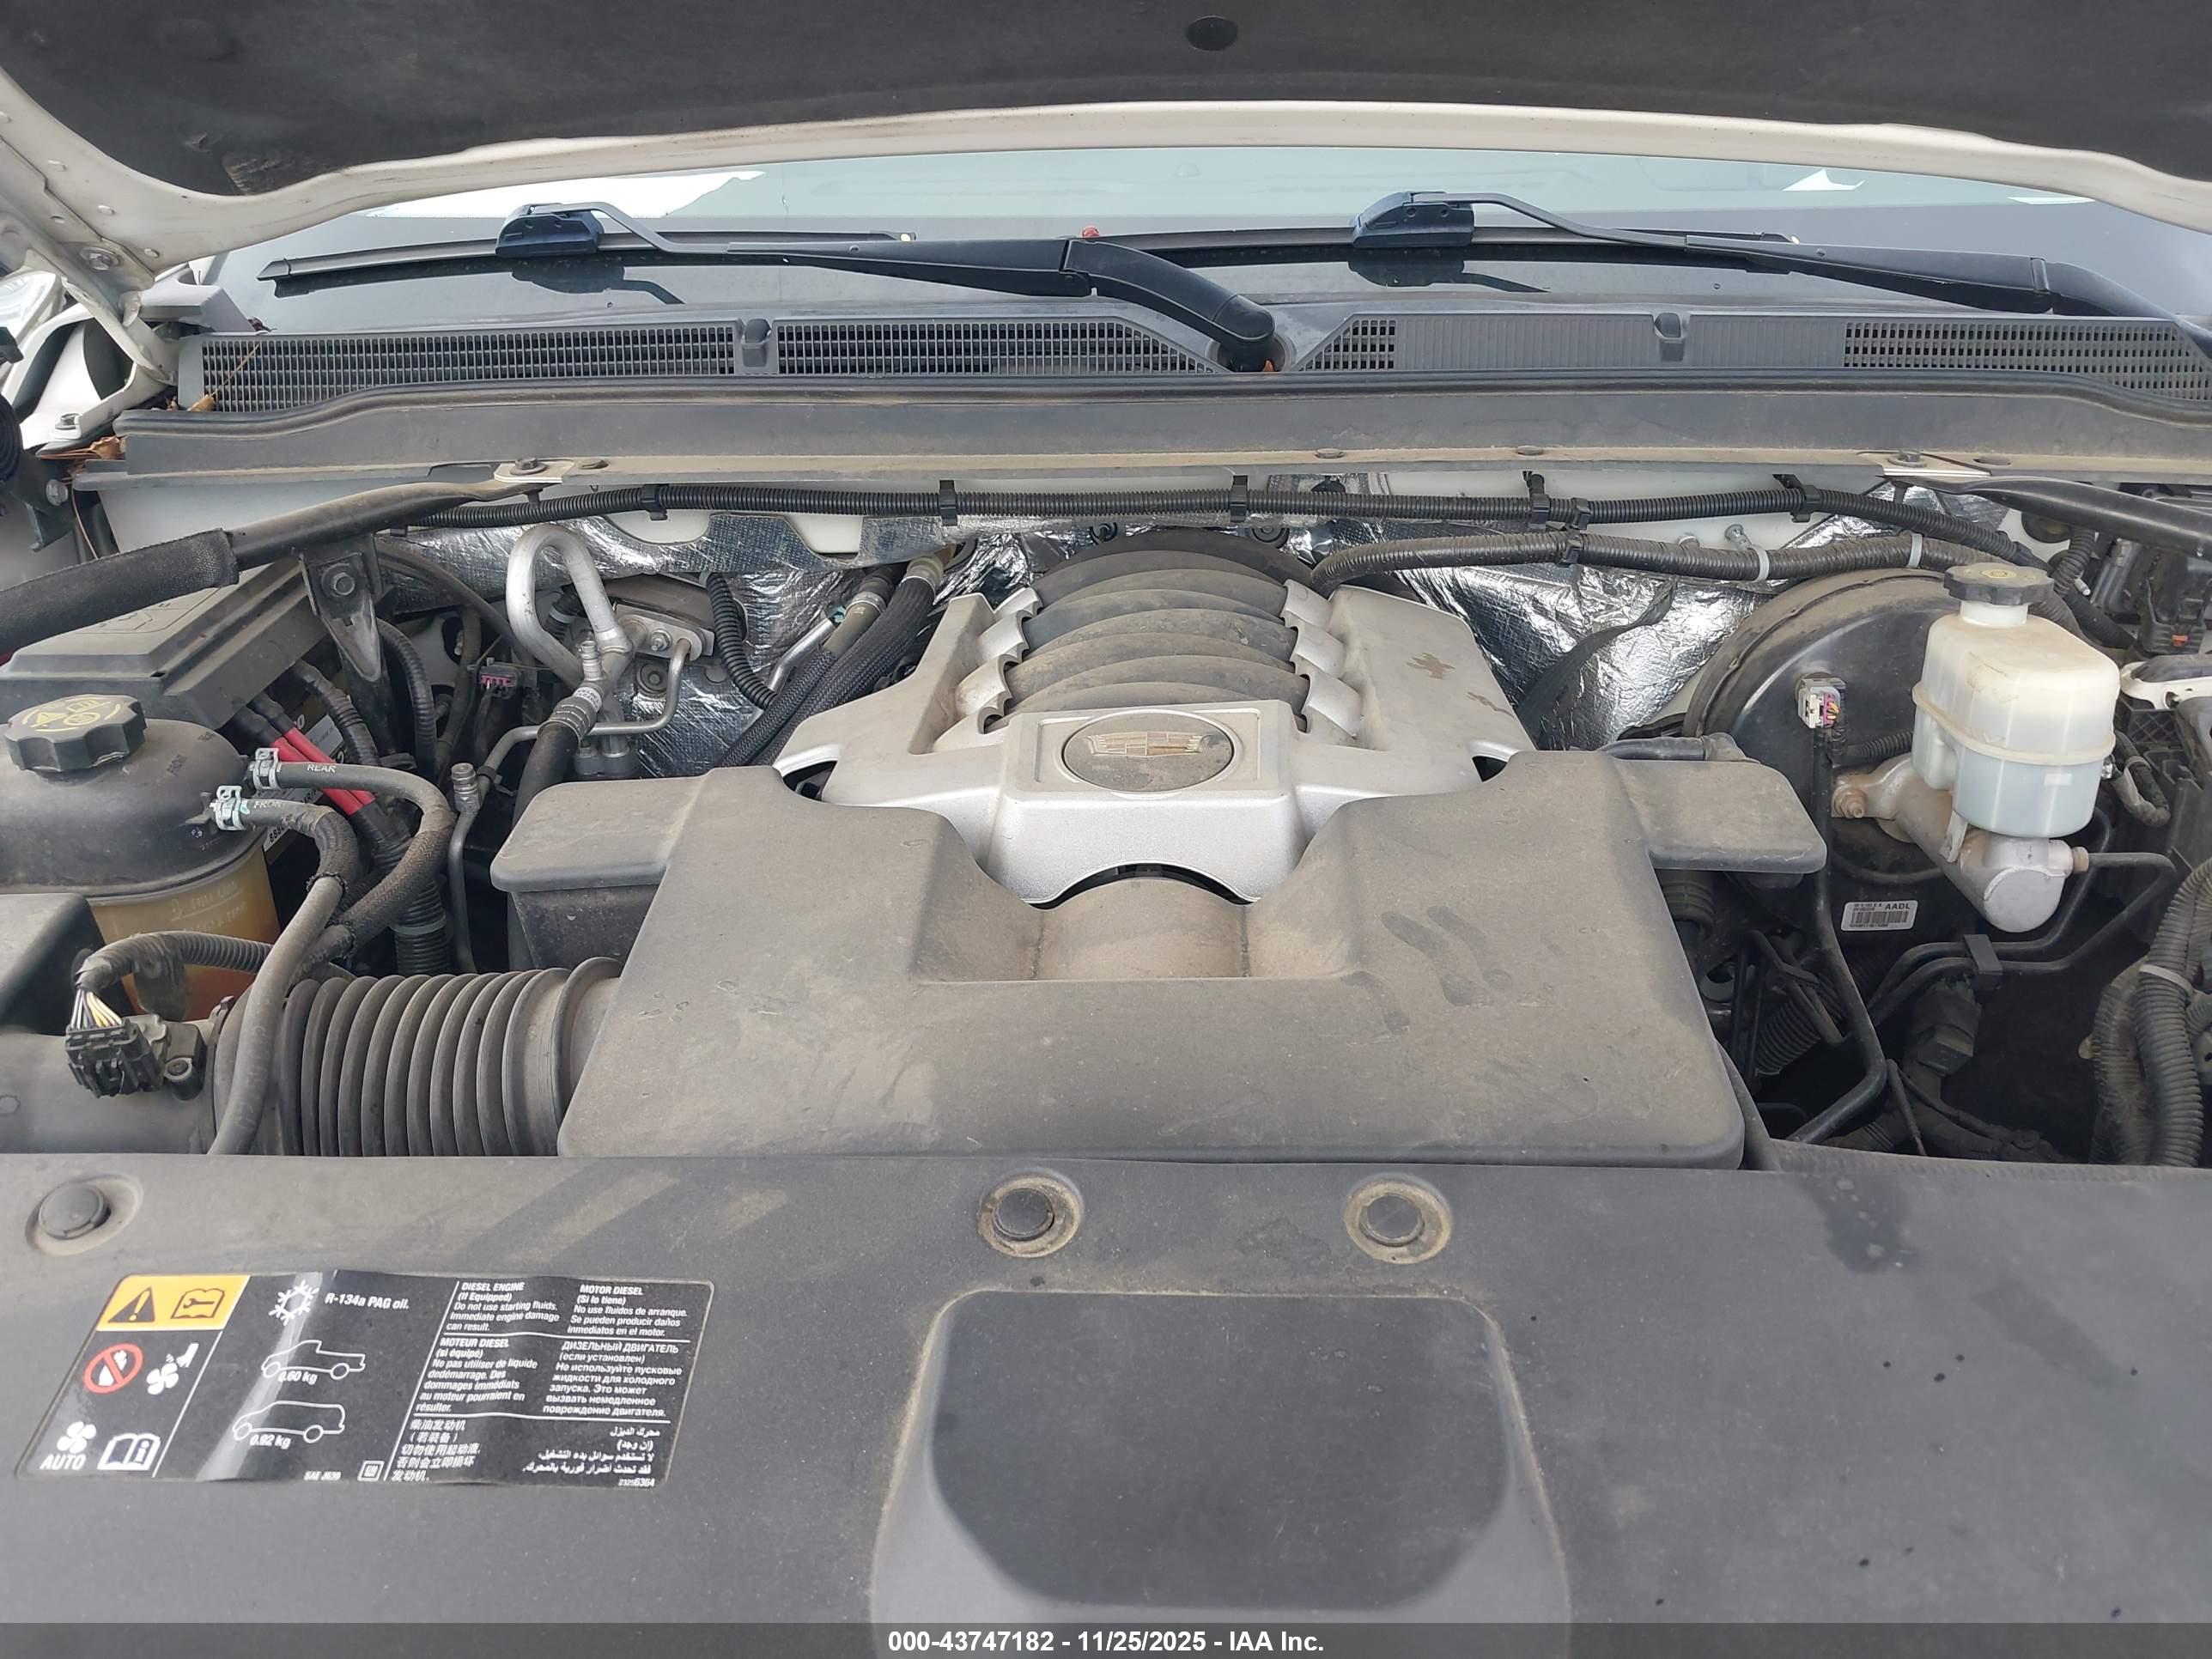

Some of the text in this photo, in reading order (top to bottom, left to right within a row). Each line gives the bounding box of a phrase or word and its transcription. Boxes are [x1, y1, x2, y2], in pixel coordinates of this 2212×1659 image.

[307, 763, 337, 773] REAR
[461, 1282, 526, 1291] DIESEL ENGINE
[580, 1284, 643, 1296] MOTOR DIESEL
[325, 1292, 410, 1309] R-134a PAG oil.
[469, 1292, 513, 1303] Equipped)
[601, 1296, 626, 1306] tiene)
[454, 1302, 466, 1311] Do
[468, 1303, 482, 1311] not
[500, 1302, 531, 1313] starting
[532, 1300, 557, 1311] fluids.
[574, 1304, 586, 1314] No
[605, 1306, 634, 1316] fluidos
[635, 1307, 647, 1316] de
[647, 1309, 688, 1318] arranque.
[450, 1310, 560, 1323] Immediate engine damage
[570, 1315, 681, 1327] Se pueden producir daños
[464, 1322, 490, 1331] result.
[568, 1325, 614, 1335] inmediatos
[629, 1327, 638, 1335] el
[639, 1328, 665, 1337] motor.
[440, 1338, 509, 1348] MOTEUR DIESEL
[561, 1340, 679, 1354] ДИЗЕЛЬНЫЙ ДВИГАТЕЛЬ
[449, 1349, 483, 1359] équipé)
[559, 1352, 646, 1364] (если установлен)
[432, 1358, 538, 1370] No pas utiliser de liquide
[556, 1362, 683, 1376] Не используйте пусковые
[302, 1371, 318, 1386] kg
[489, 1370, 506, 1379] Des
[552, 1374, 676, 1386] жидкости для холодного
[423, 1379, 520, 1392] dommages immédiats
[550, 1383, 647, 1395] запуска. Это может
[419, 1390, 526, 1403] au moteur pourraient en
[545, 1394, 656, 1406] вызвать немедленное
[415, 1402, 452, 1413] résulter.
[543, 1404, 666, 1418] повреждение двигателя.
[409, 1419, 466, 1431] 柴油发动机
[609, 1425, 660, 1437] محرك الديزل
[275, 1435, 292, 1449] kg
[588, 1450, 614, 1462] سوائل
[615, 1451, 646, 1462] تستخدم
[647, 1452, 655, 1462] لا
[39, 1454, 87, 1471] AUTO
[612, 1463, 636, 1474] تحدث
[637, 1463, 652, 1474] فقد
